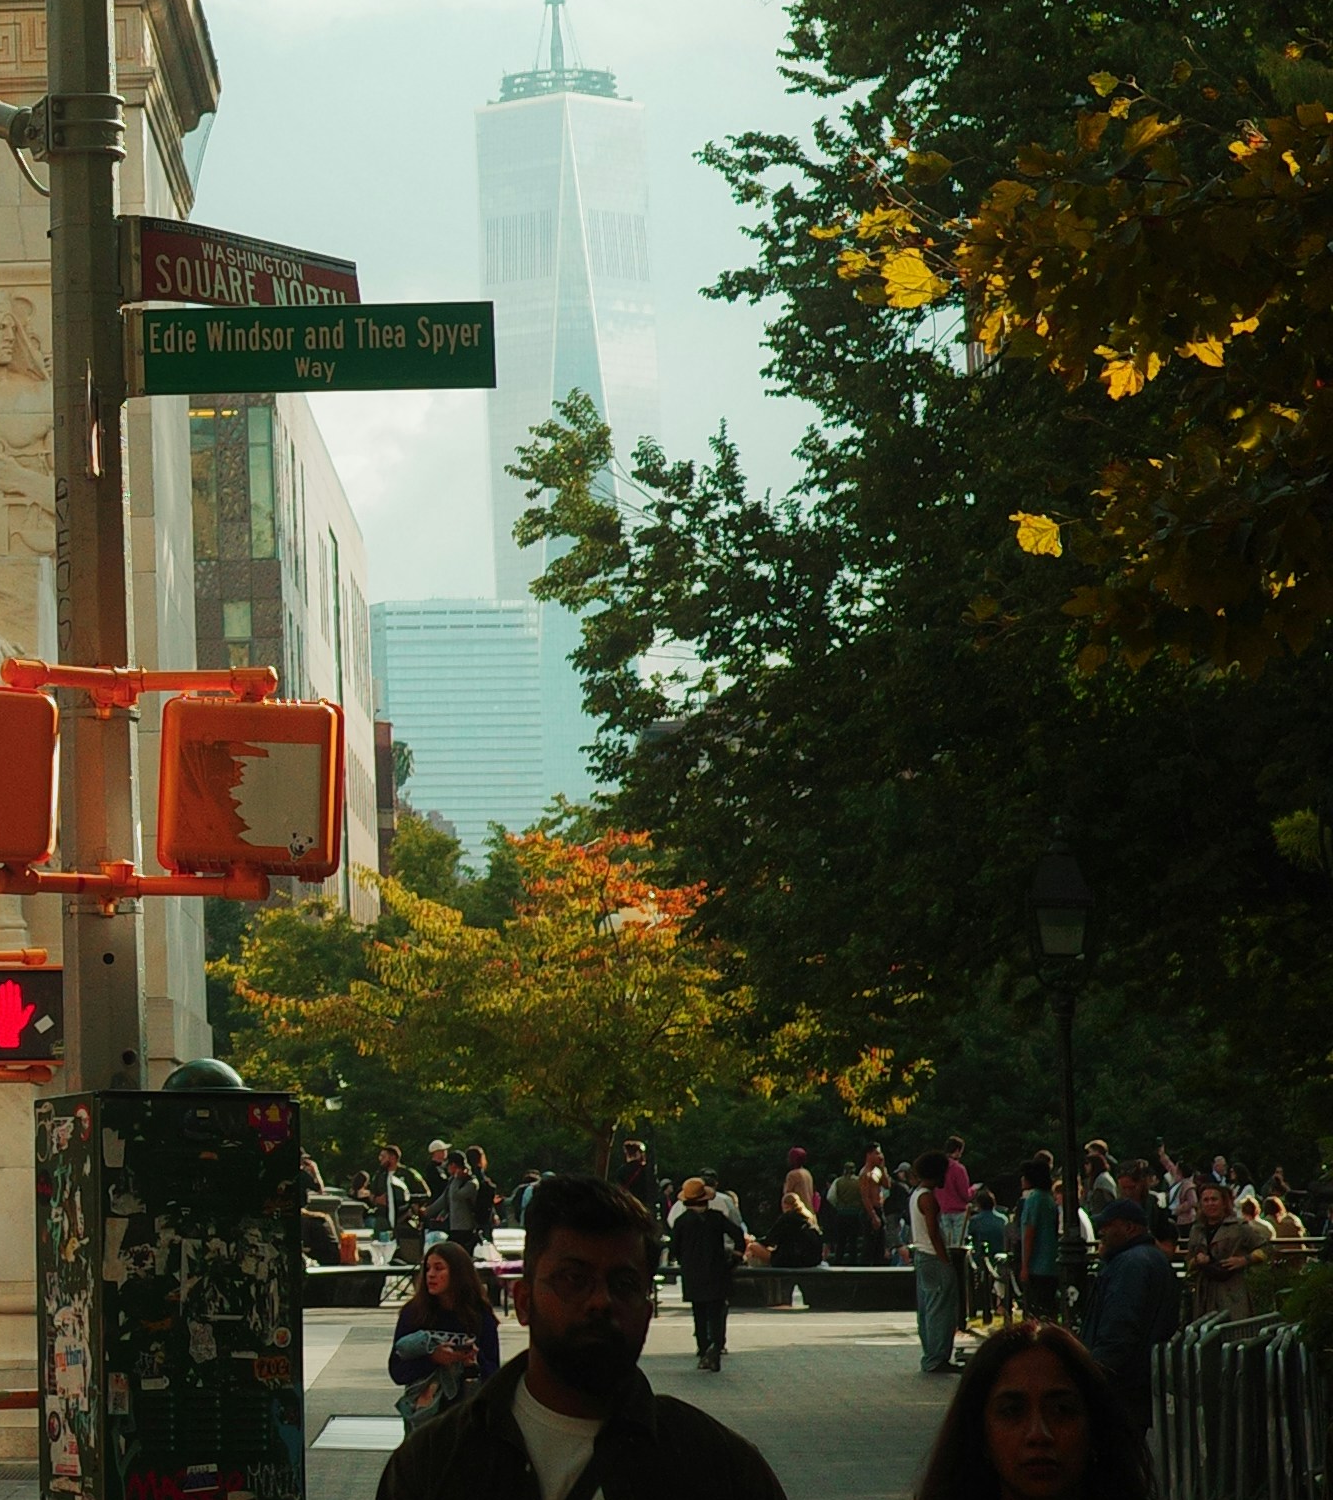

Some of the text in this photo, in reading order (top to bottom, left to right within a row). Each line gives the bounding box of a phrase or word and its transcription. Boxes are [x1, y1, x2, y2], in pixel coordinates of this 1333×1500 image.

[155, 254, 260, 307] SQUARE
[201, 242, 303, 281] WASHINGTON
[149, 316, 482, 355] Edie Windsor and Thea Spyer
[295, 357, 336, 383] Way
